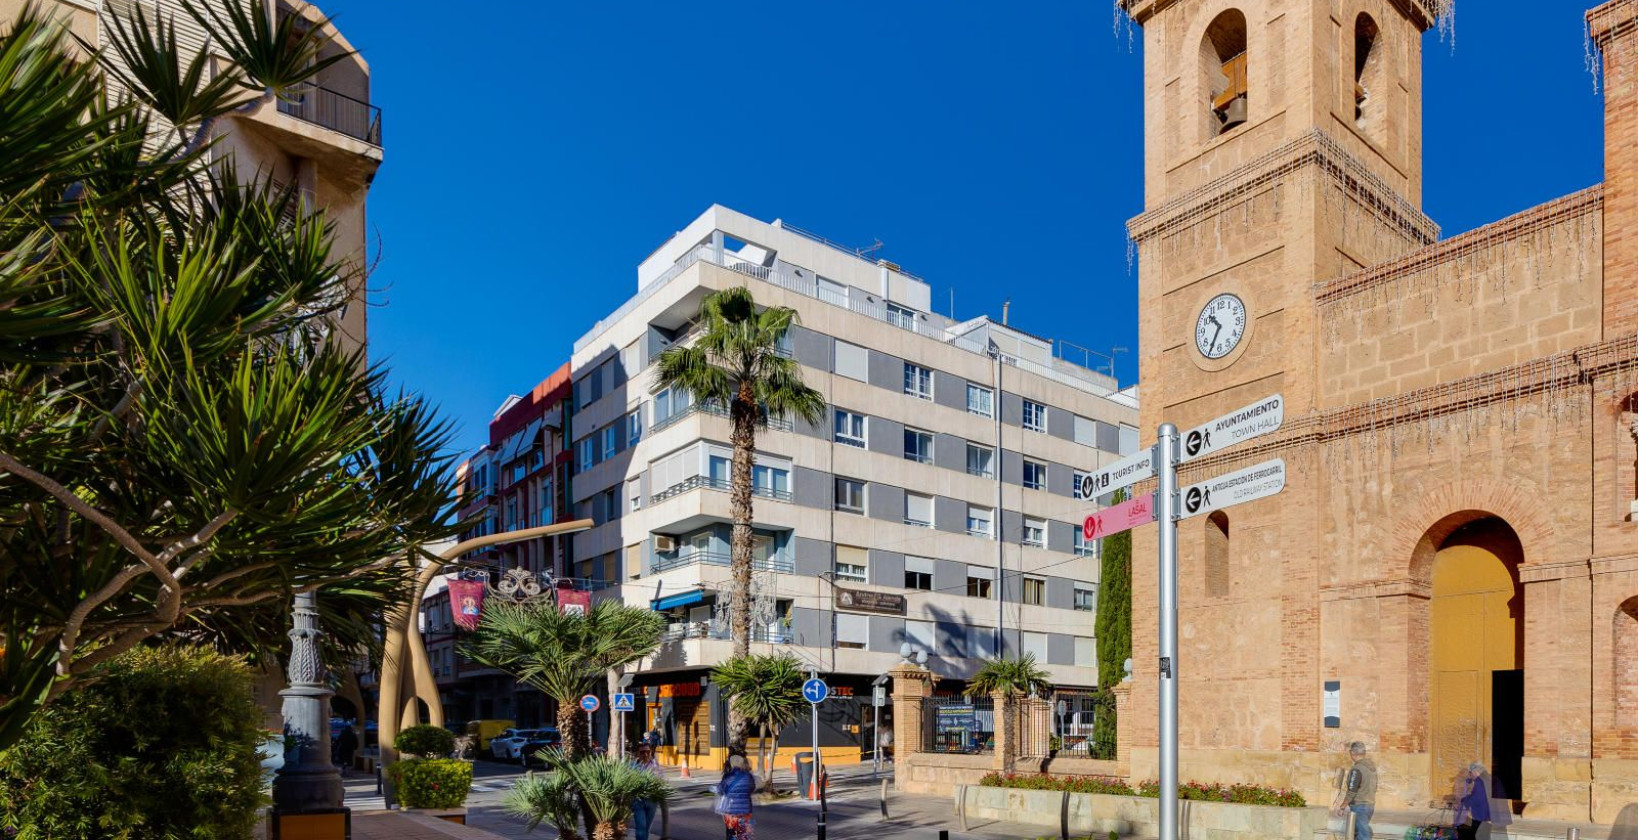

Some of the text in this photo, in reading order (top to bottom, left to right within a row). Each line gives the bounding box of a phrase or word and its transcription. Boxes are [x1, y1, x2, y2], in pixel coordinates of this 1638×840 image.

[1217, 300, 1225, 310] 12
[1210, 306, 1215, 315] 11
[1232, 306, 1238, 315] 2
[1235, 316, 1241, 326] 3
[1200, 327, 1206, 337] 9
[1203, 337, 1208, 347] 8
[1225, 338, 1231, 347] 5
[1217, 344, 1222, 352] 6
[1215, 399, 1279, 432] AYUNTAMIENTO
[1232, 416, 1279, 439] TOWN HALL
[1113, 458, 1150, 480] TOURIST INFO
